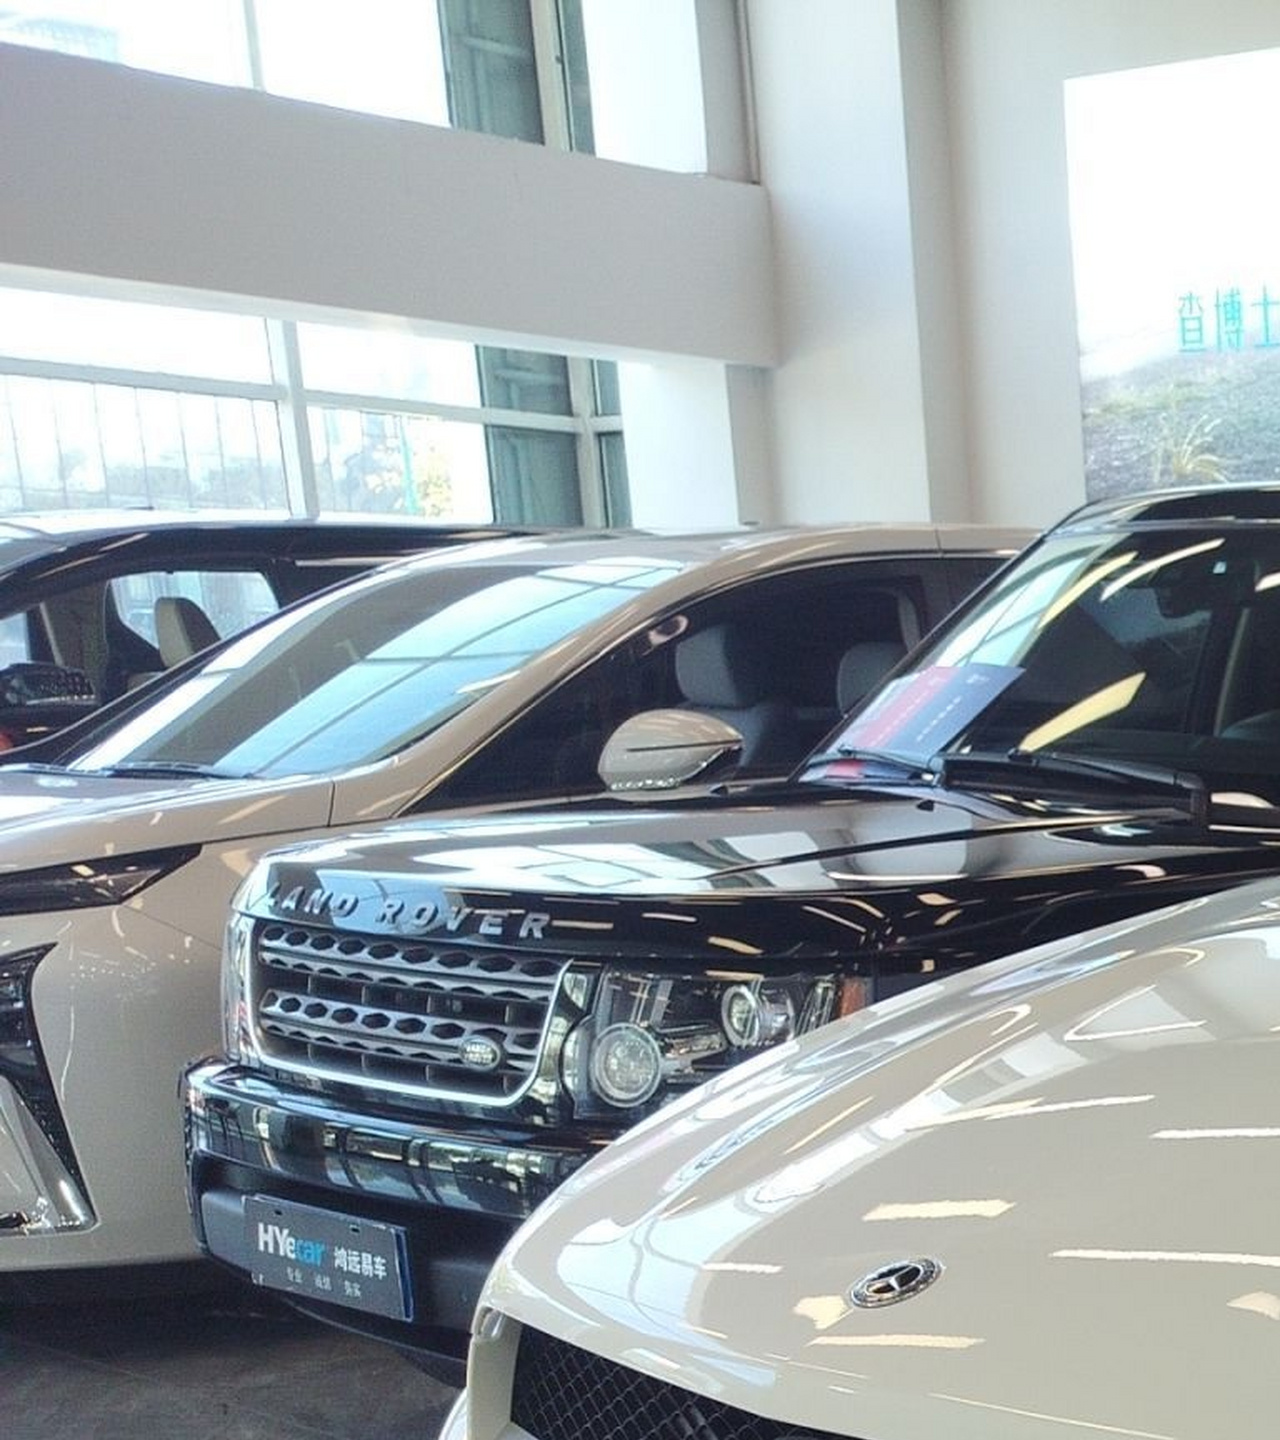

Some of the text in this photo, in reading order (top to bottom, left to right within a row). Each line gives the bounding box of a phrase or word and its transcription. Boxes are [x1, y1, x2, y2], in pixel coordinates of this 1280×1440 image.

[267, 882, 551, 939] LAND ROVER
[258, 1222, 324, 1266] HYecar
